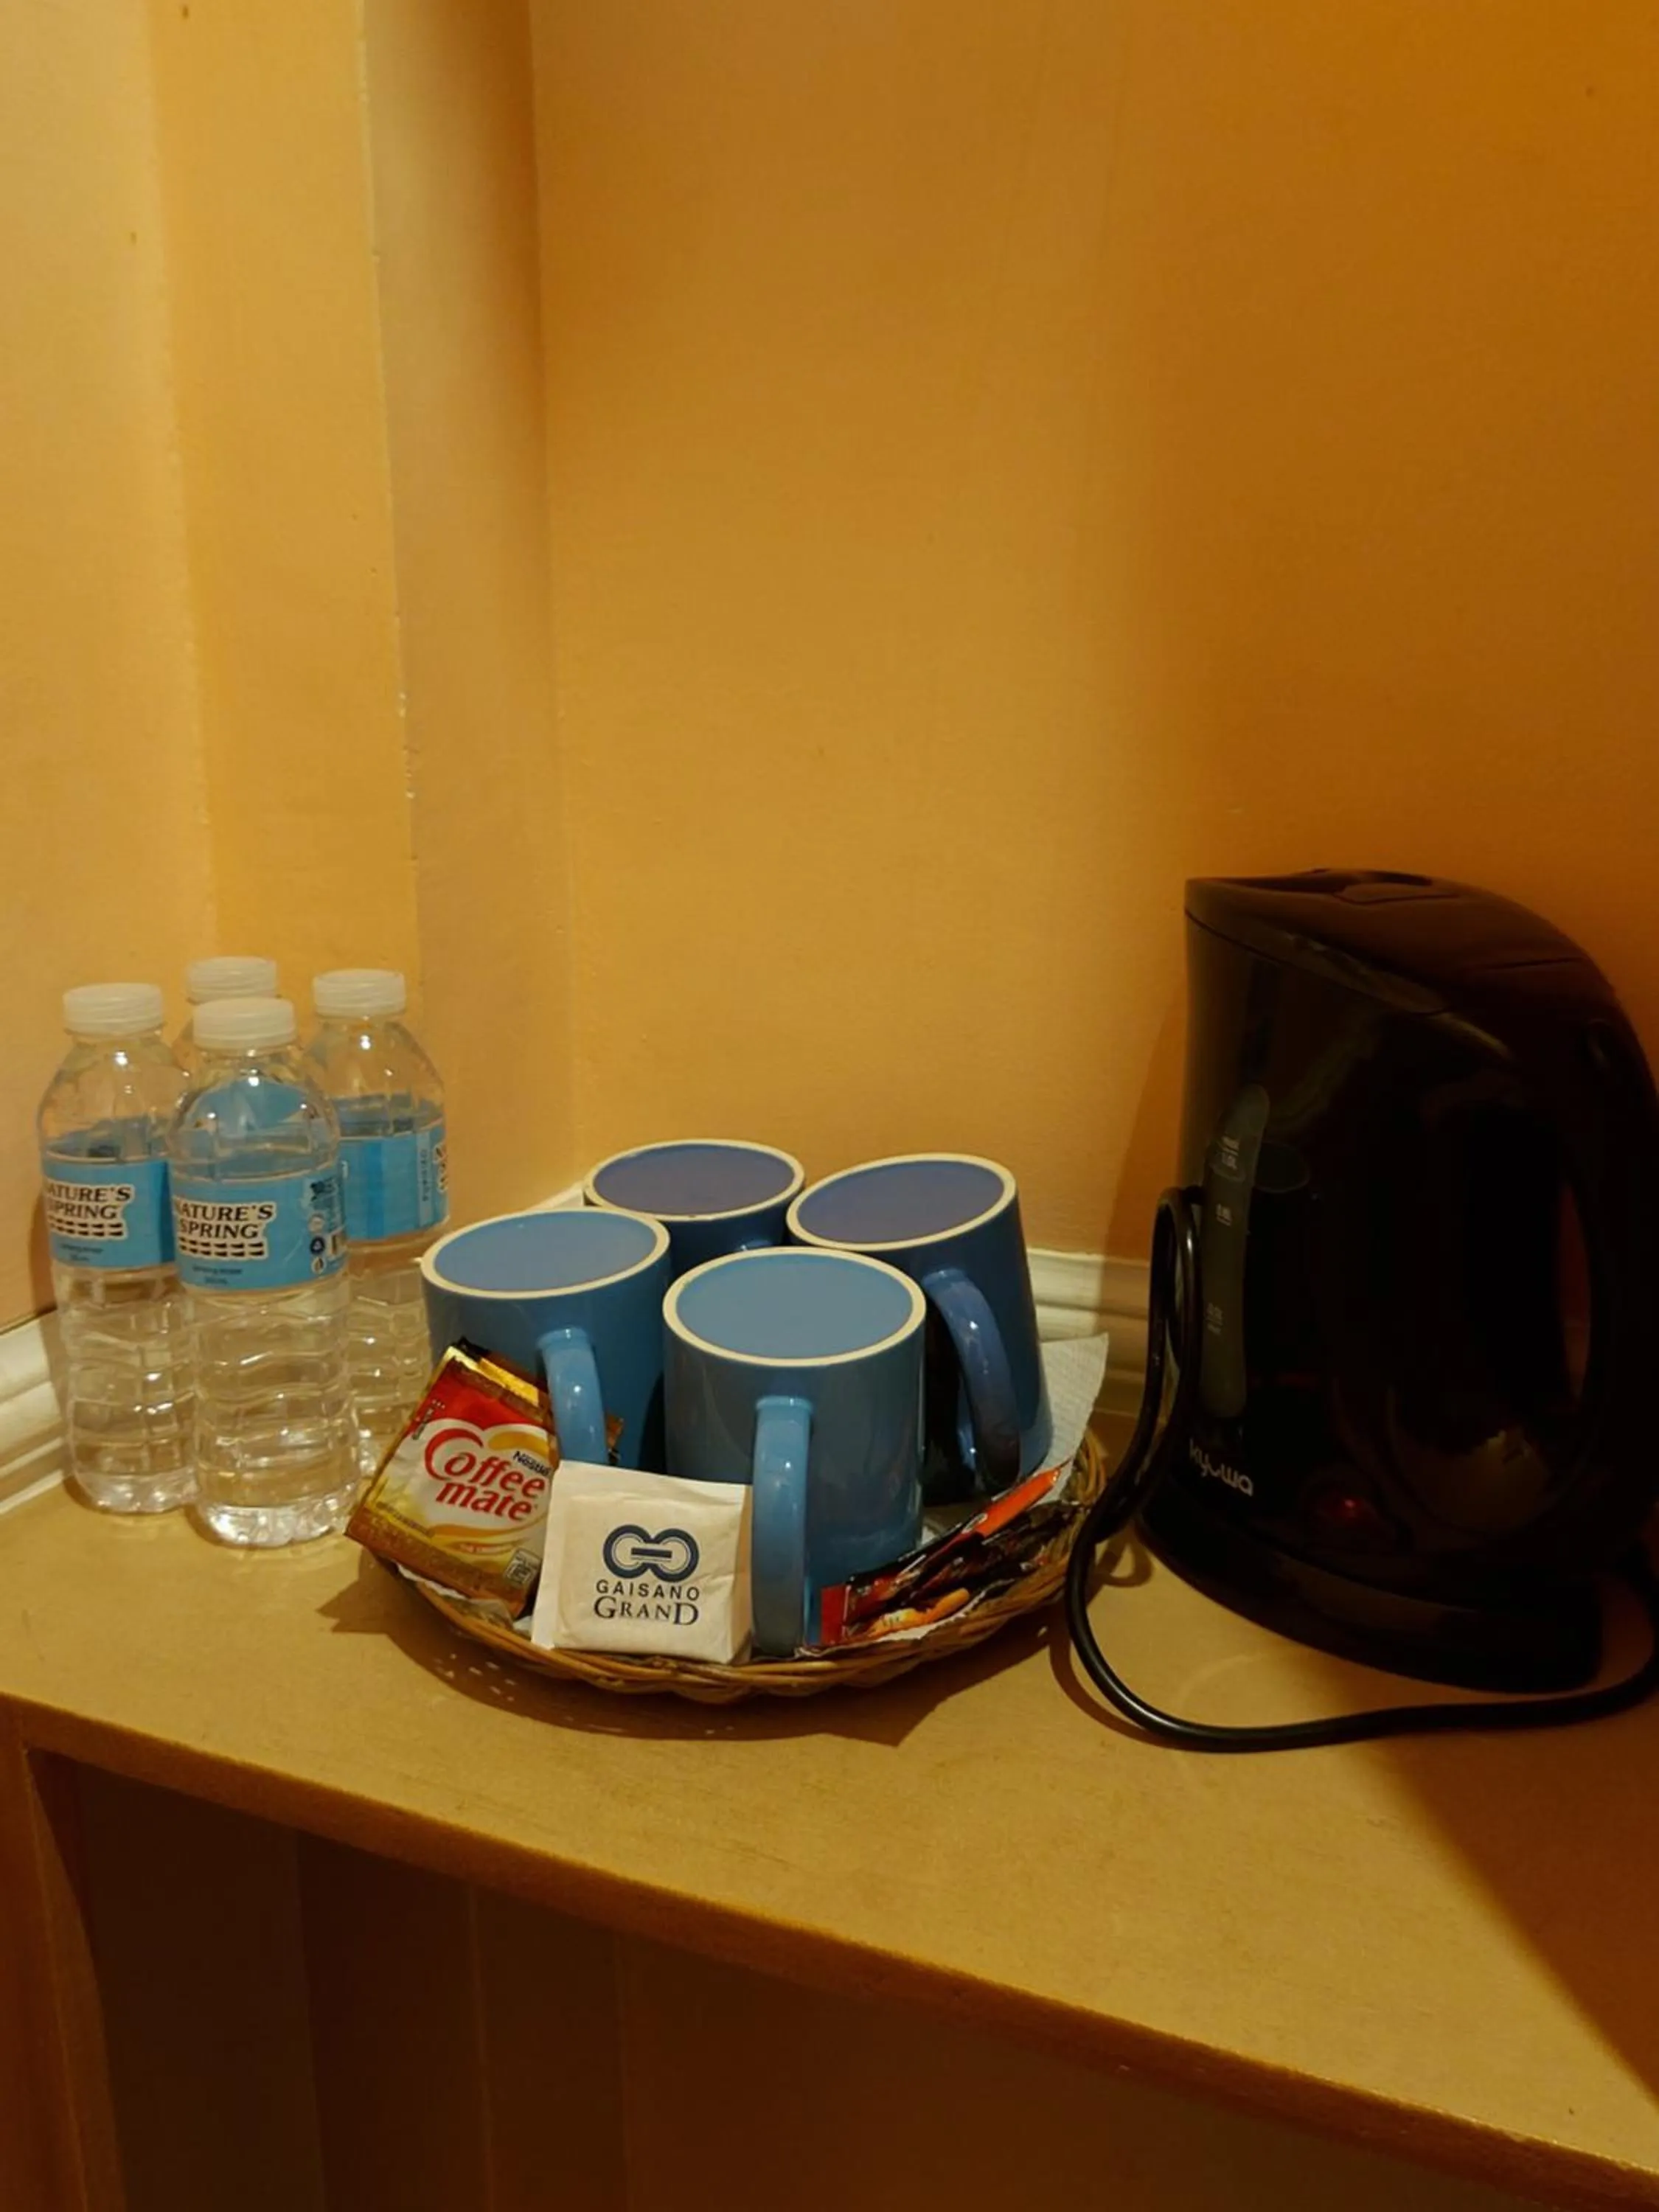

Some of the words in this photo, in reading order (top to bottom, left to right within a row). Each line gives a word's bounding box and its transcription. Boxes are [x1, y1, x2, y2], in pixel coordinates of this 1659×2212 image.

[45, 1183, 131, 1202] ATURE'S
[180, 1217, 259, 1239] SPRING
[424, 1427, 546, 1498] Coffee
[437, 1482, 532, 1521] mate
[596, 1579, 700, 1601] GAISANO
[594, 1595, 699, 1626] GRAND
